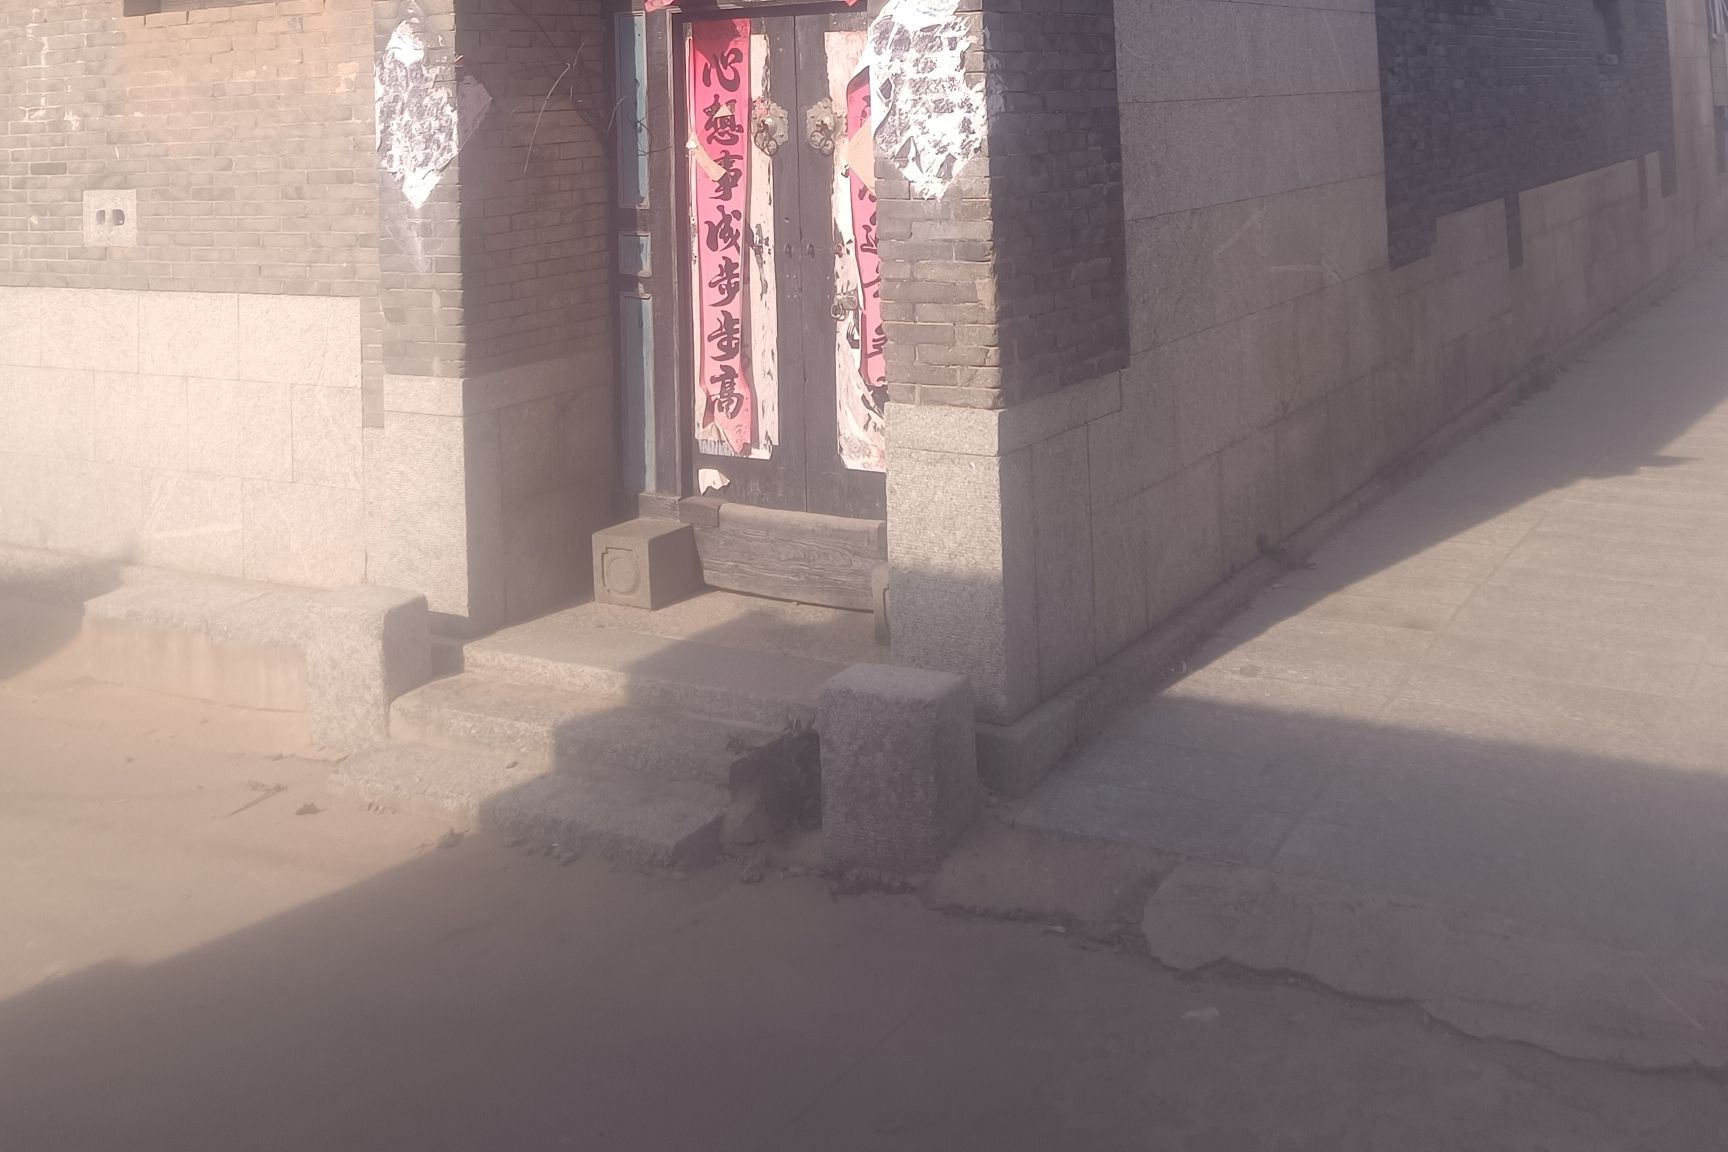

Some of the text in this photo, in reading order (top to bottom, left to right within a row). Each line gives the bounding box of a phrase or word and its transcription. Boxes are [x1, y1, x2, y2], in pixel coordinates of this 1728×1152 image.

[702, 47, 744, 420] 心想事成步步高
